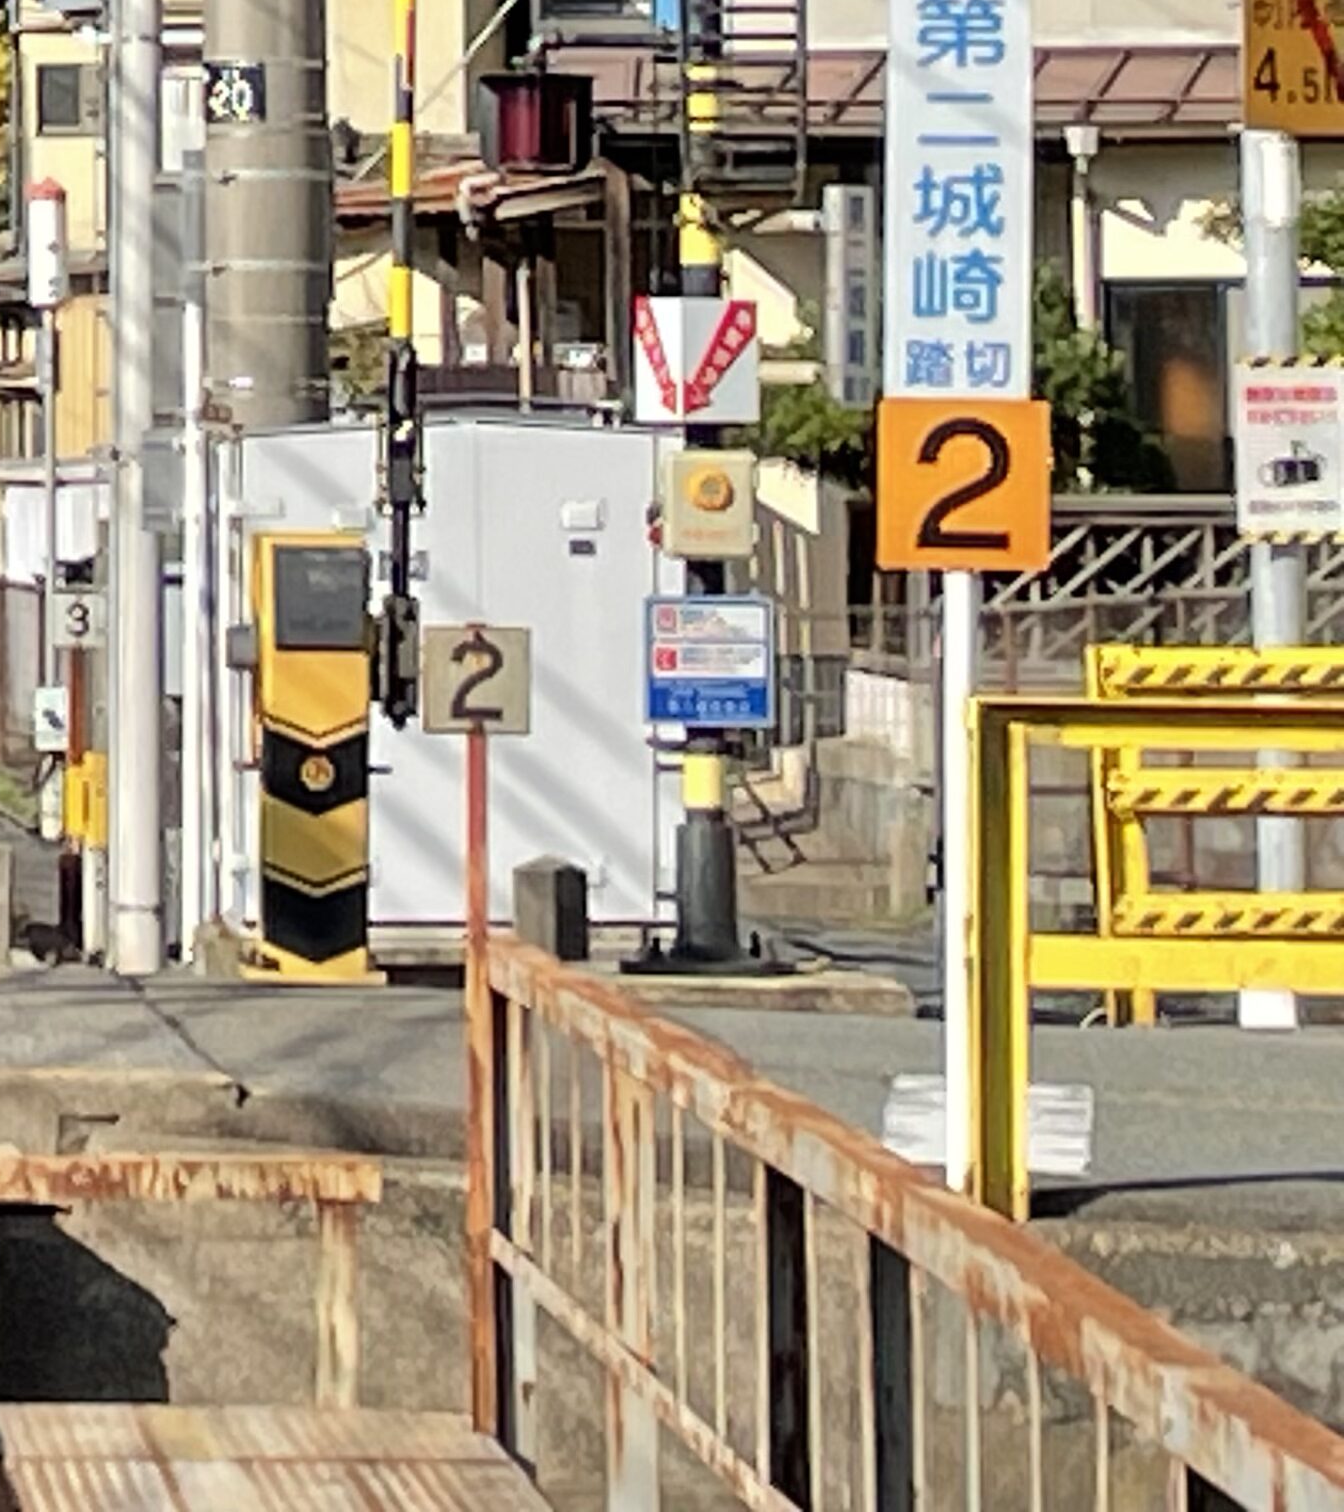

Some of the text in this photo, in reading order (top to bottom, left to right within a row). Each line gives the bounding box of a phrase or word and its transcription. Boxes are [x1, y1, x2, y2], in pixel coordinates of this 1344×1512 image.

[904, 338, 1013, 389] 踏切
[916, 416, 1011, 549] 2
[66, 602, 90, 637] 3
[450, 637, 504, 722] 2
